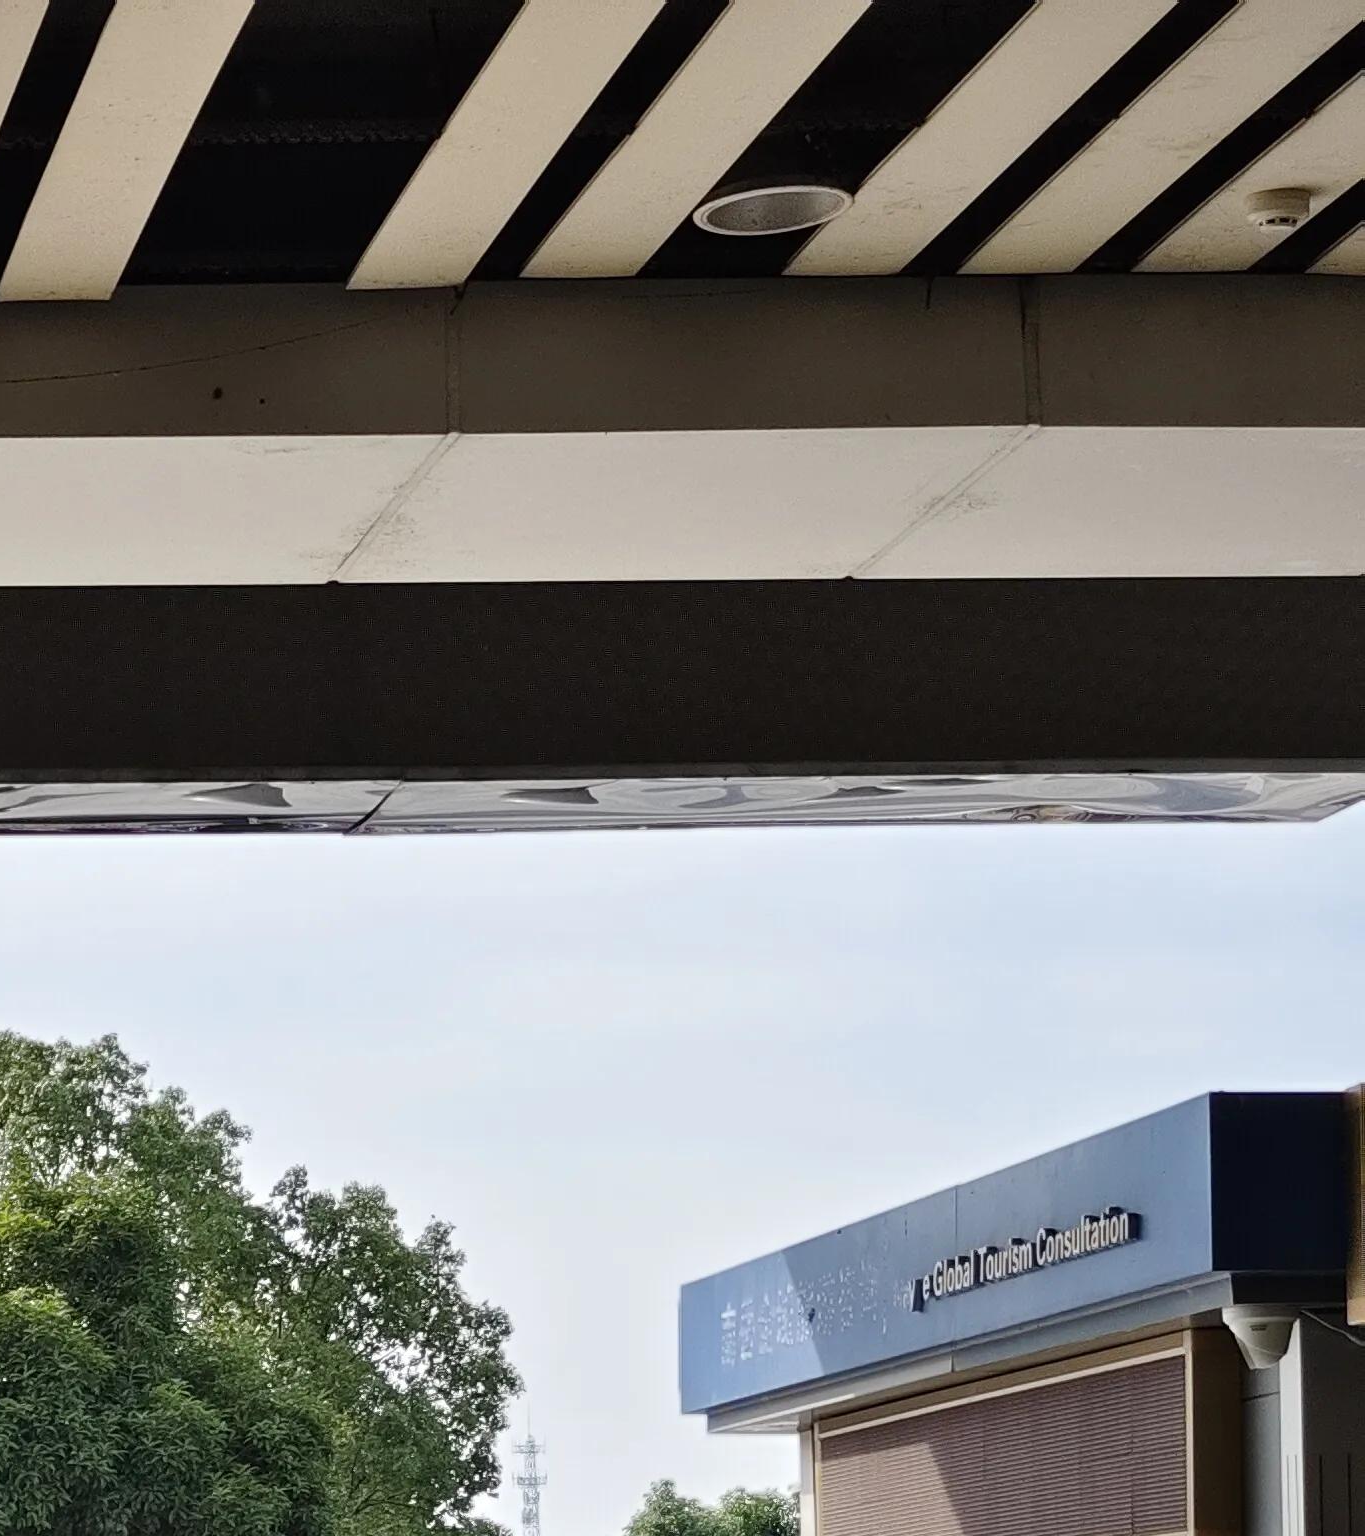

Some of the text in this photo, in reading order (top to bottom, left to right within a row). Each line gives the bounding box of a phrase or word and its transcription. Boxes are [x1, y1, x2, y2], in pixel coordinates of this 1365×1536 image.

[932, 1255, 974, 1297] Global
[977, 1237, 1033, 1281] Tourism
[1035, 1206, 1130, 1266] Consultation
